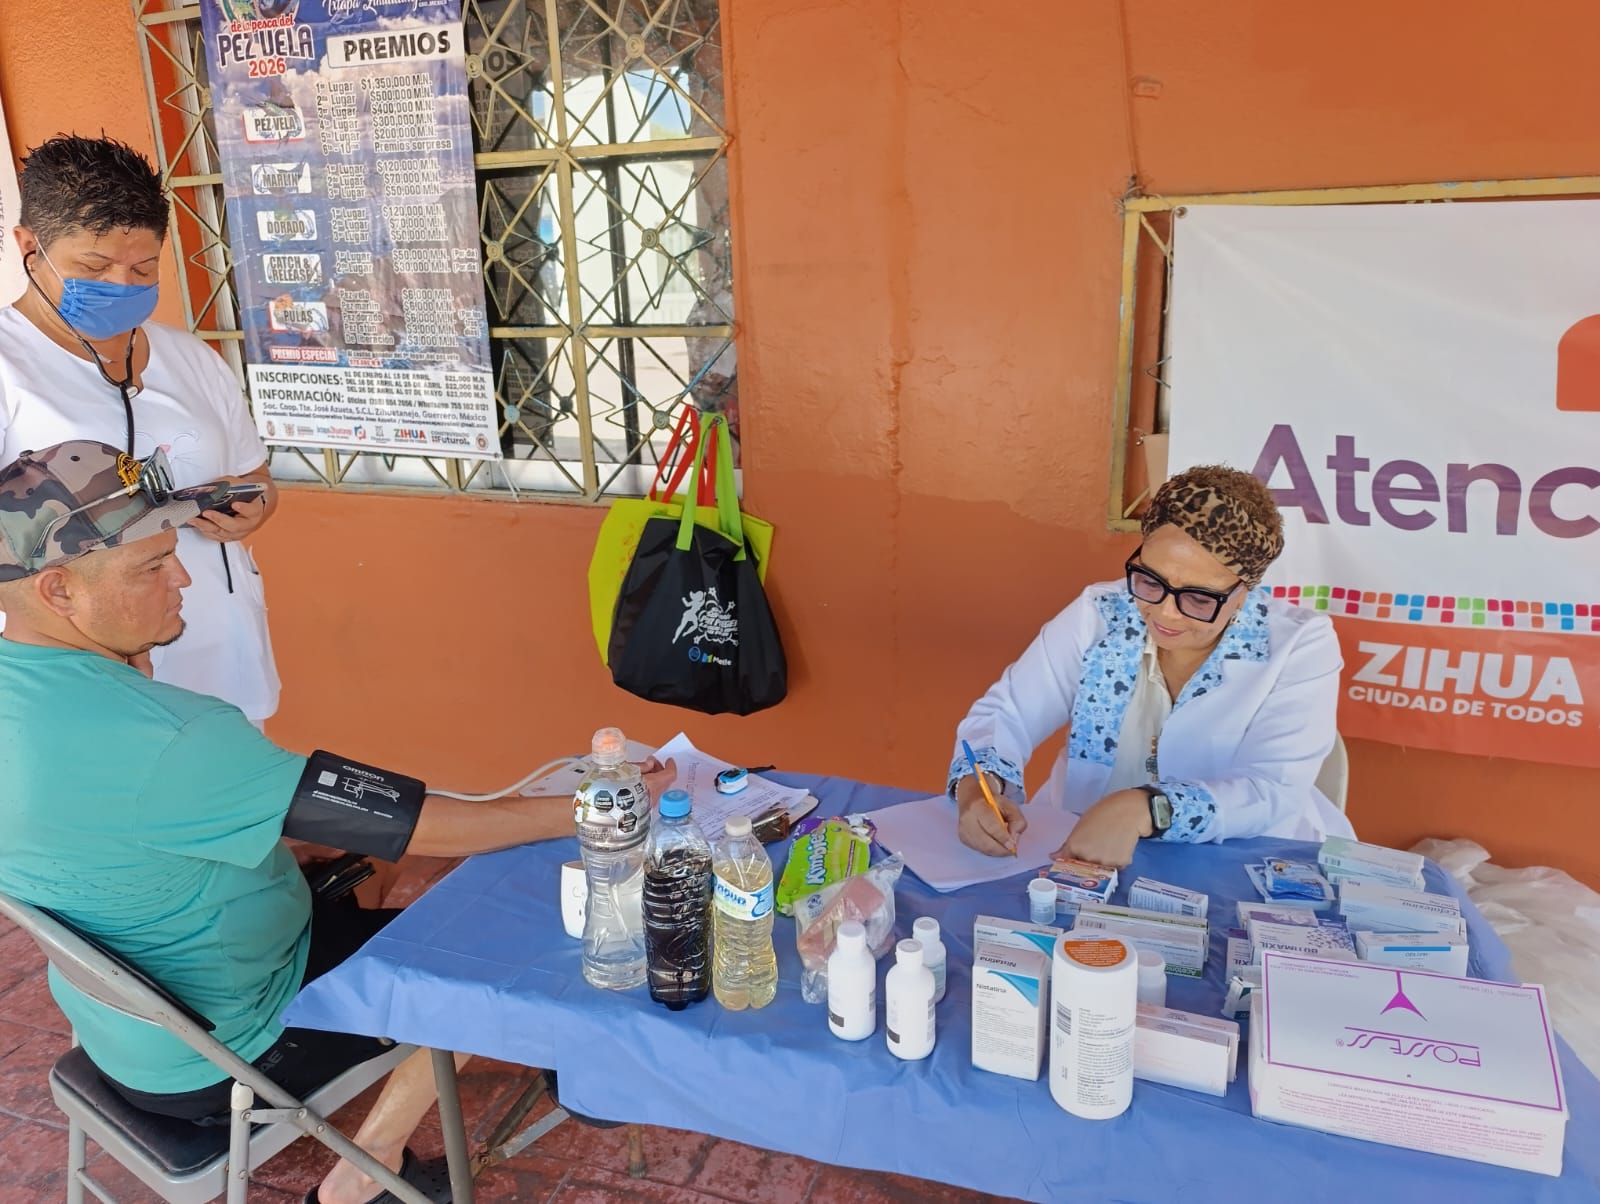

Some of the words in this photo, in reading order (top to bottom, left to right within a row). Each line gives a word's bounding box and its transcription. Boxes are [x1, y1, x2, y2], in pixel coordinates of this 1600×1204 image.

[231, 22, 241, 32] de
[252, 20, 278, 30] pesca
[280, 15, 294, 26] del
[218, 35, 256, 66] PEZ
[344, 31, 450, 61] PREMIOS
[249, 58, 285, 76] 2026
[329, 83, 352, 94] Lugar
[361, 76, 410, 90] $1,350,000
[331, 95, 355, 106] Lugar
[370, 88, 411, 101] $500,000
[332, 107, 355, 118] Lugar
[372, 101, 413, 114] $400,000
[255, 119, 271, 131] PEZ
[273, 117, 296, 130] VELA
[333, 120, 358, 130] Lugar
[373, 115, 415, 126] $300,000
[335, 131, 359, 142] Lugar
[375, 128, 416, 139] $200,000
[375, 142, 410, 152] Premios
[413, 140, 451, 151] sorpresa
[340, 166, 363, 176] Lugar
[377, 161, 418, 173] $120,000
[340, 177, 363, 187] Lugar
[385, 173, 419, 184] $70,000
[342, 189, 365, 199] Lugar
[386, 186, 421, 196] $50,000
[343, 209, 365, 218] Lugar
[383, 206, 424, 217] $120,000
[267, 221, 305, 233] DORADO
[344, 220, 367, 231] Lugar
[345, 232, 368, 243] Lugar
[393, 249, 429, 260] $50,000
[270, 256, 301, 269] CATCH
[303, 258, 309, 268] &
[272, 269, 314, 281] RELEASE
[284, 310, 313, 323] PULAS
[256, 372, 344, 385] INSCRIPCIONES:
[259, 388, 344, 403] INFORMACIÓN:
[422, 411, 458, 420] Guerrero,
[460, 413, 486, 421] México
[394, 429, 426, 439] ZIHUA
[1351, 640, 1585, 706] ZIHUA
[1347, 685, 1446, 714] CIUDAD
[1452, 697, 1485, 717] DE
[1490, 702, 1584, 727] TODOS
[980, 956, 1017, 968] Nistatina
